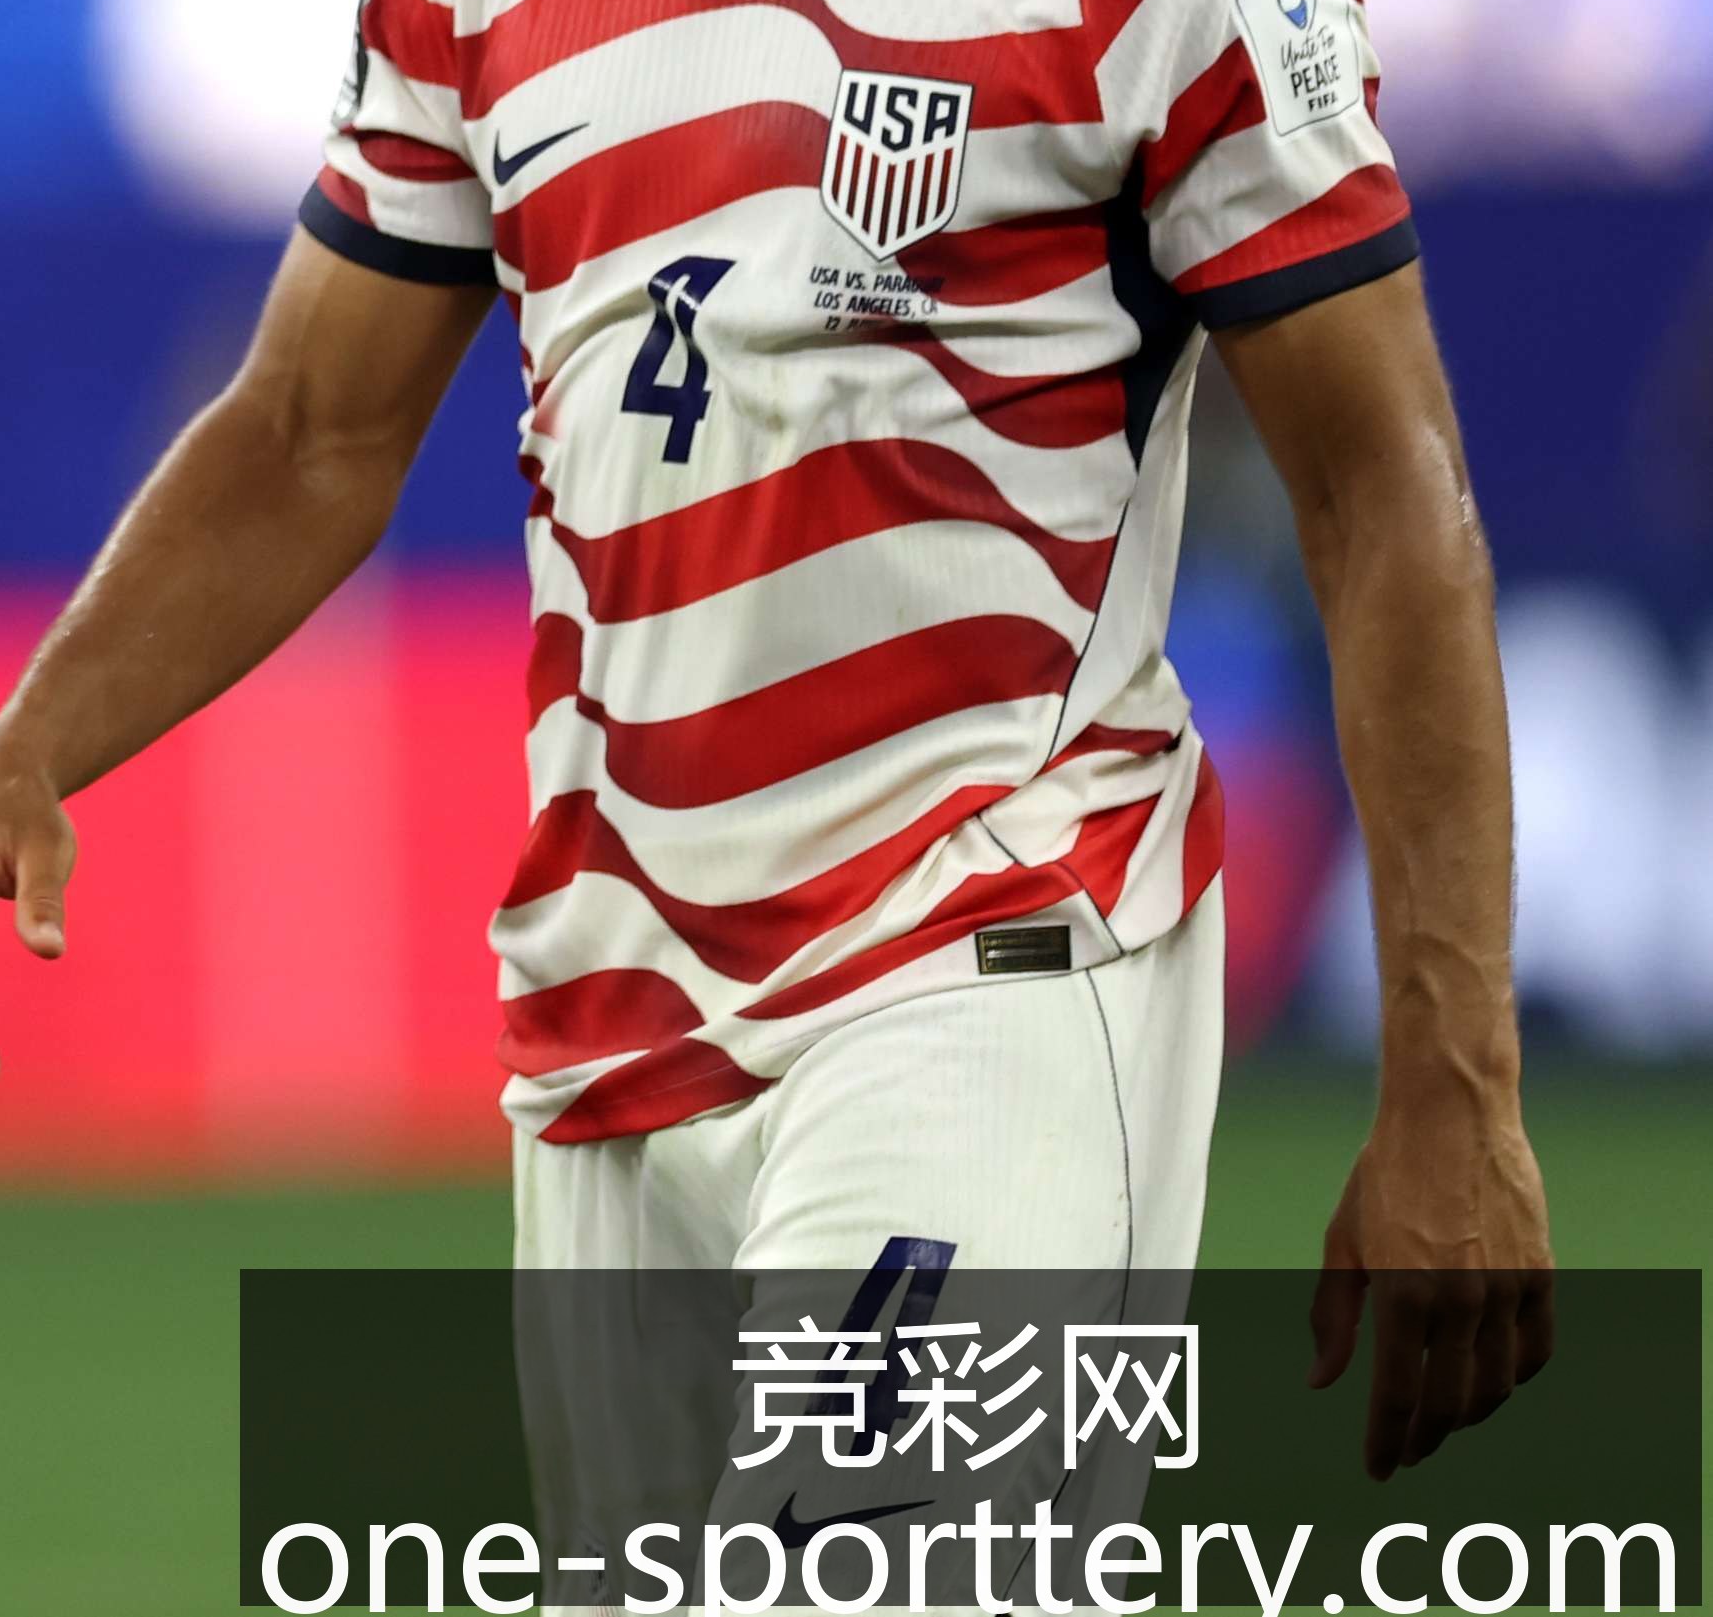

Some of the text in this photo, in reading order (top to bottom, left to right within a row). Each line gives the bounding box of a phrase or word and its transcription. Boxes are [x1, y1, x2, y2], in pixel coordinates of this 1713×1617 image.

[1291, 53, 1340, 97] PEACE
[844, 82, 961, 152] USA
[810, 266, 839, 285] USA
[845, 272, 866, 290] VS.
[815, 291, 843, 310] LOS
[621, 255, 737, 464] 4
